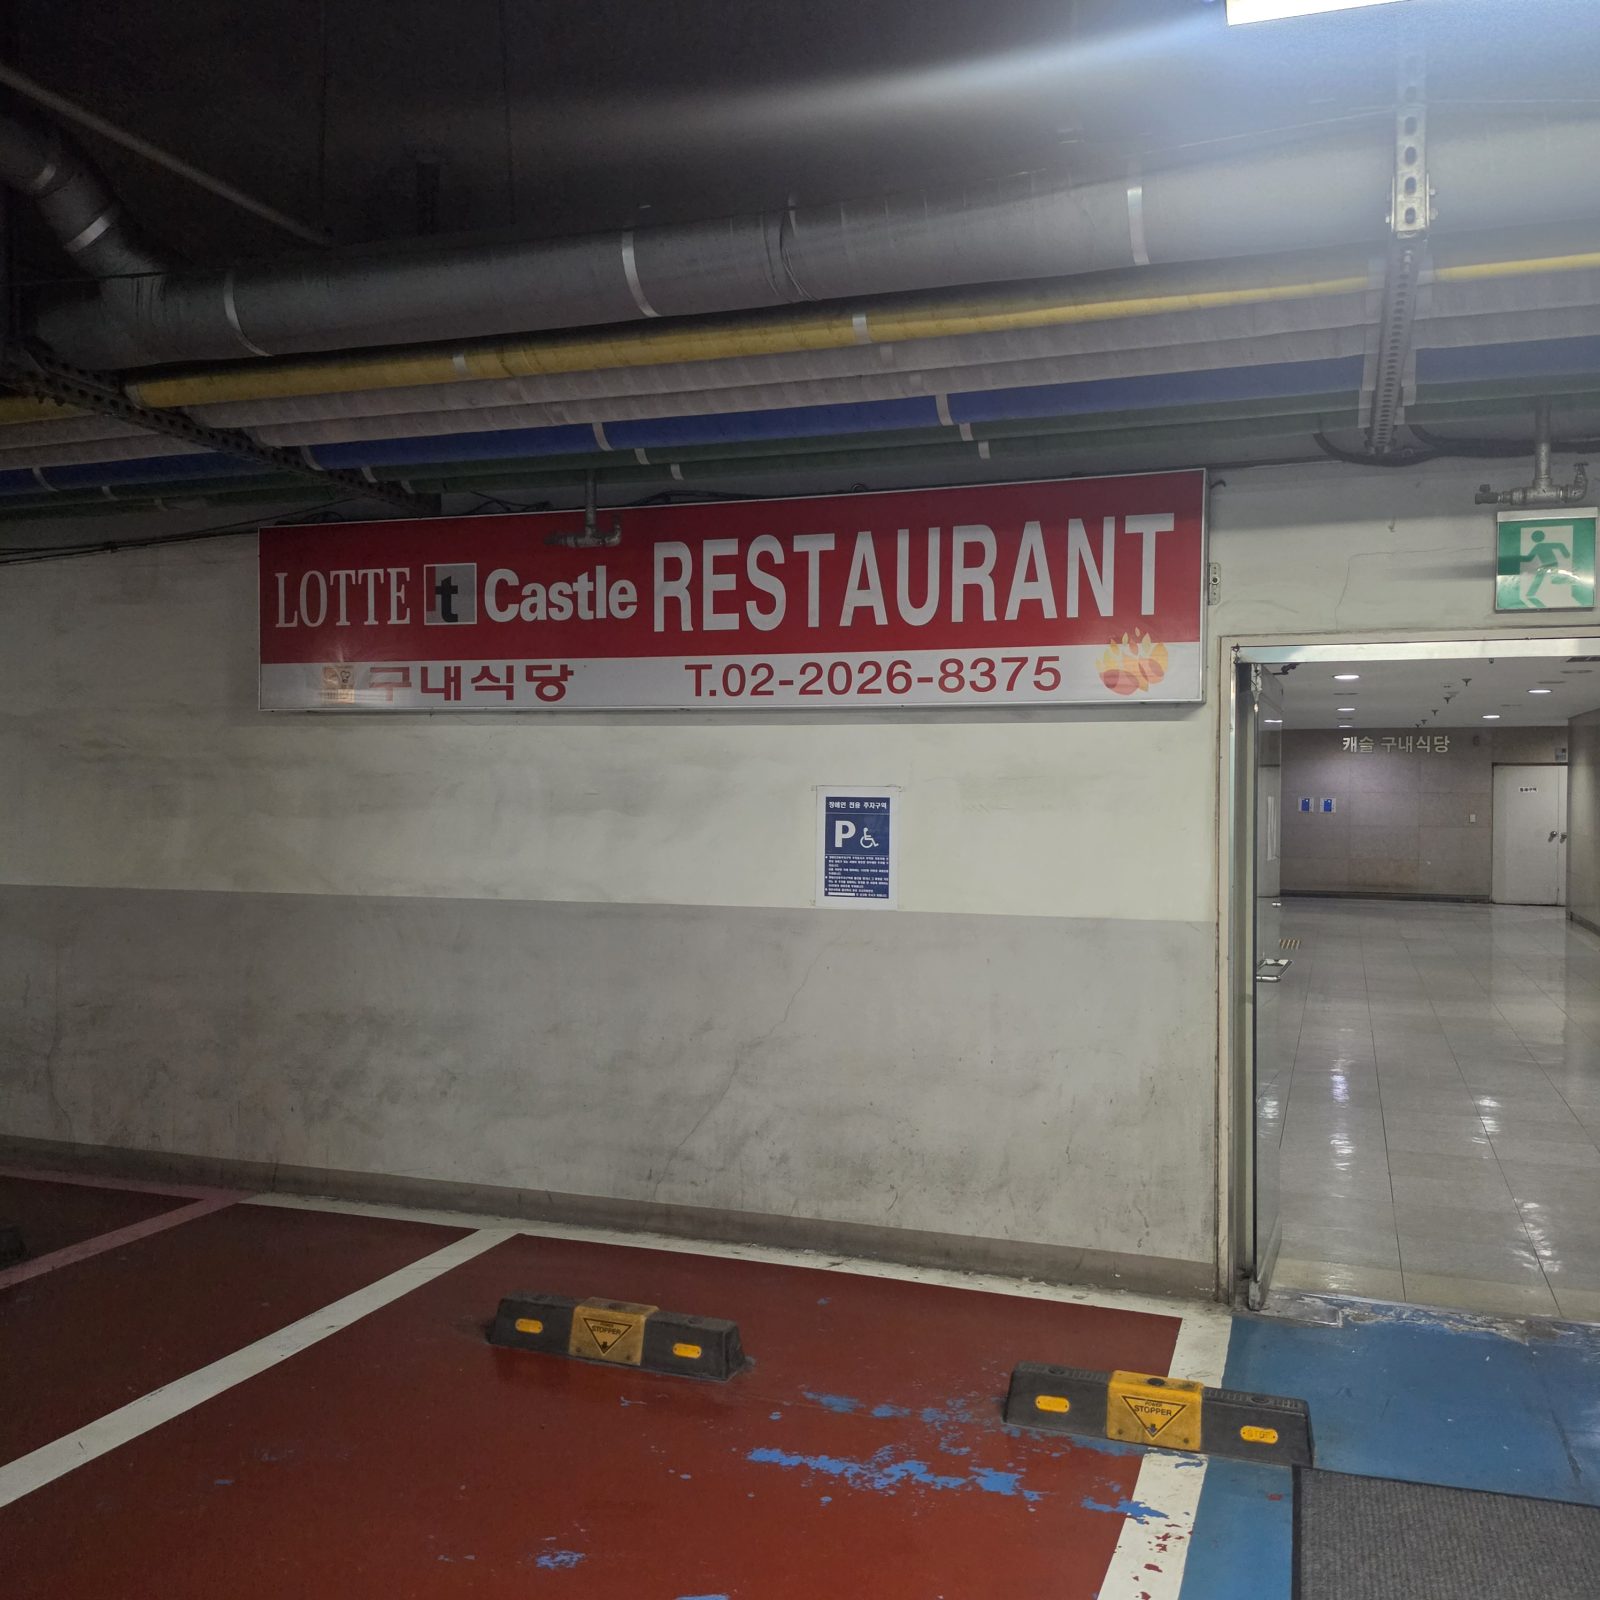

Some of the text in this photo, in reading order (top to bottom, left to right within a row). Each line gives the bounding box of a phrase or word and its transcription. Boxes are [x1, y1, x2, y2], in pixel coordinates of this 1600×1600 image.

[274, 567, 411, 629] LOTTE
[484, 565, 638, 623] Castle
[652, 512, 1175, 633] RESTAURANT
[368, 664, 575, 703] 구내식당
[684, 655, 1062, 698] T.02-2026-8375
[1342, 735, 1451, 753] 캐슬 구내식당
[828, 801, 846, 809] 장애인
[863, 801, 887, 809] 주차구역
[834, 820, 857, 848] P
[1134, 1404, 1172, 1416] STOPPER
